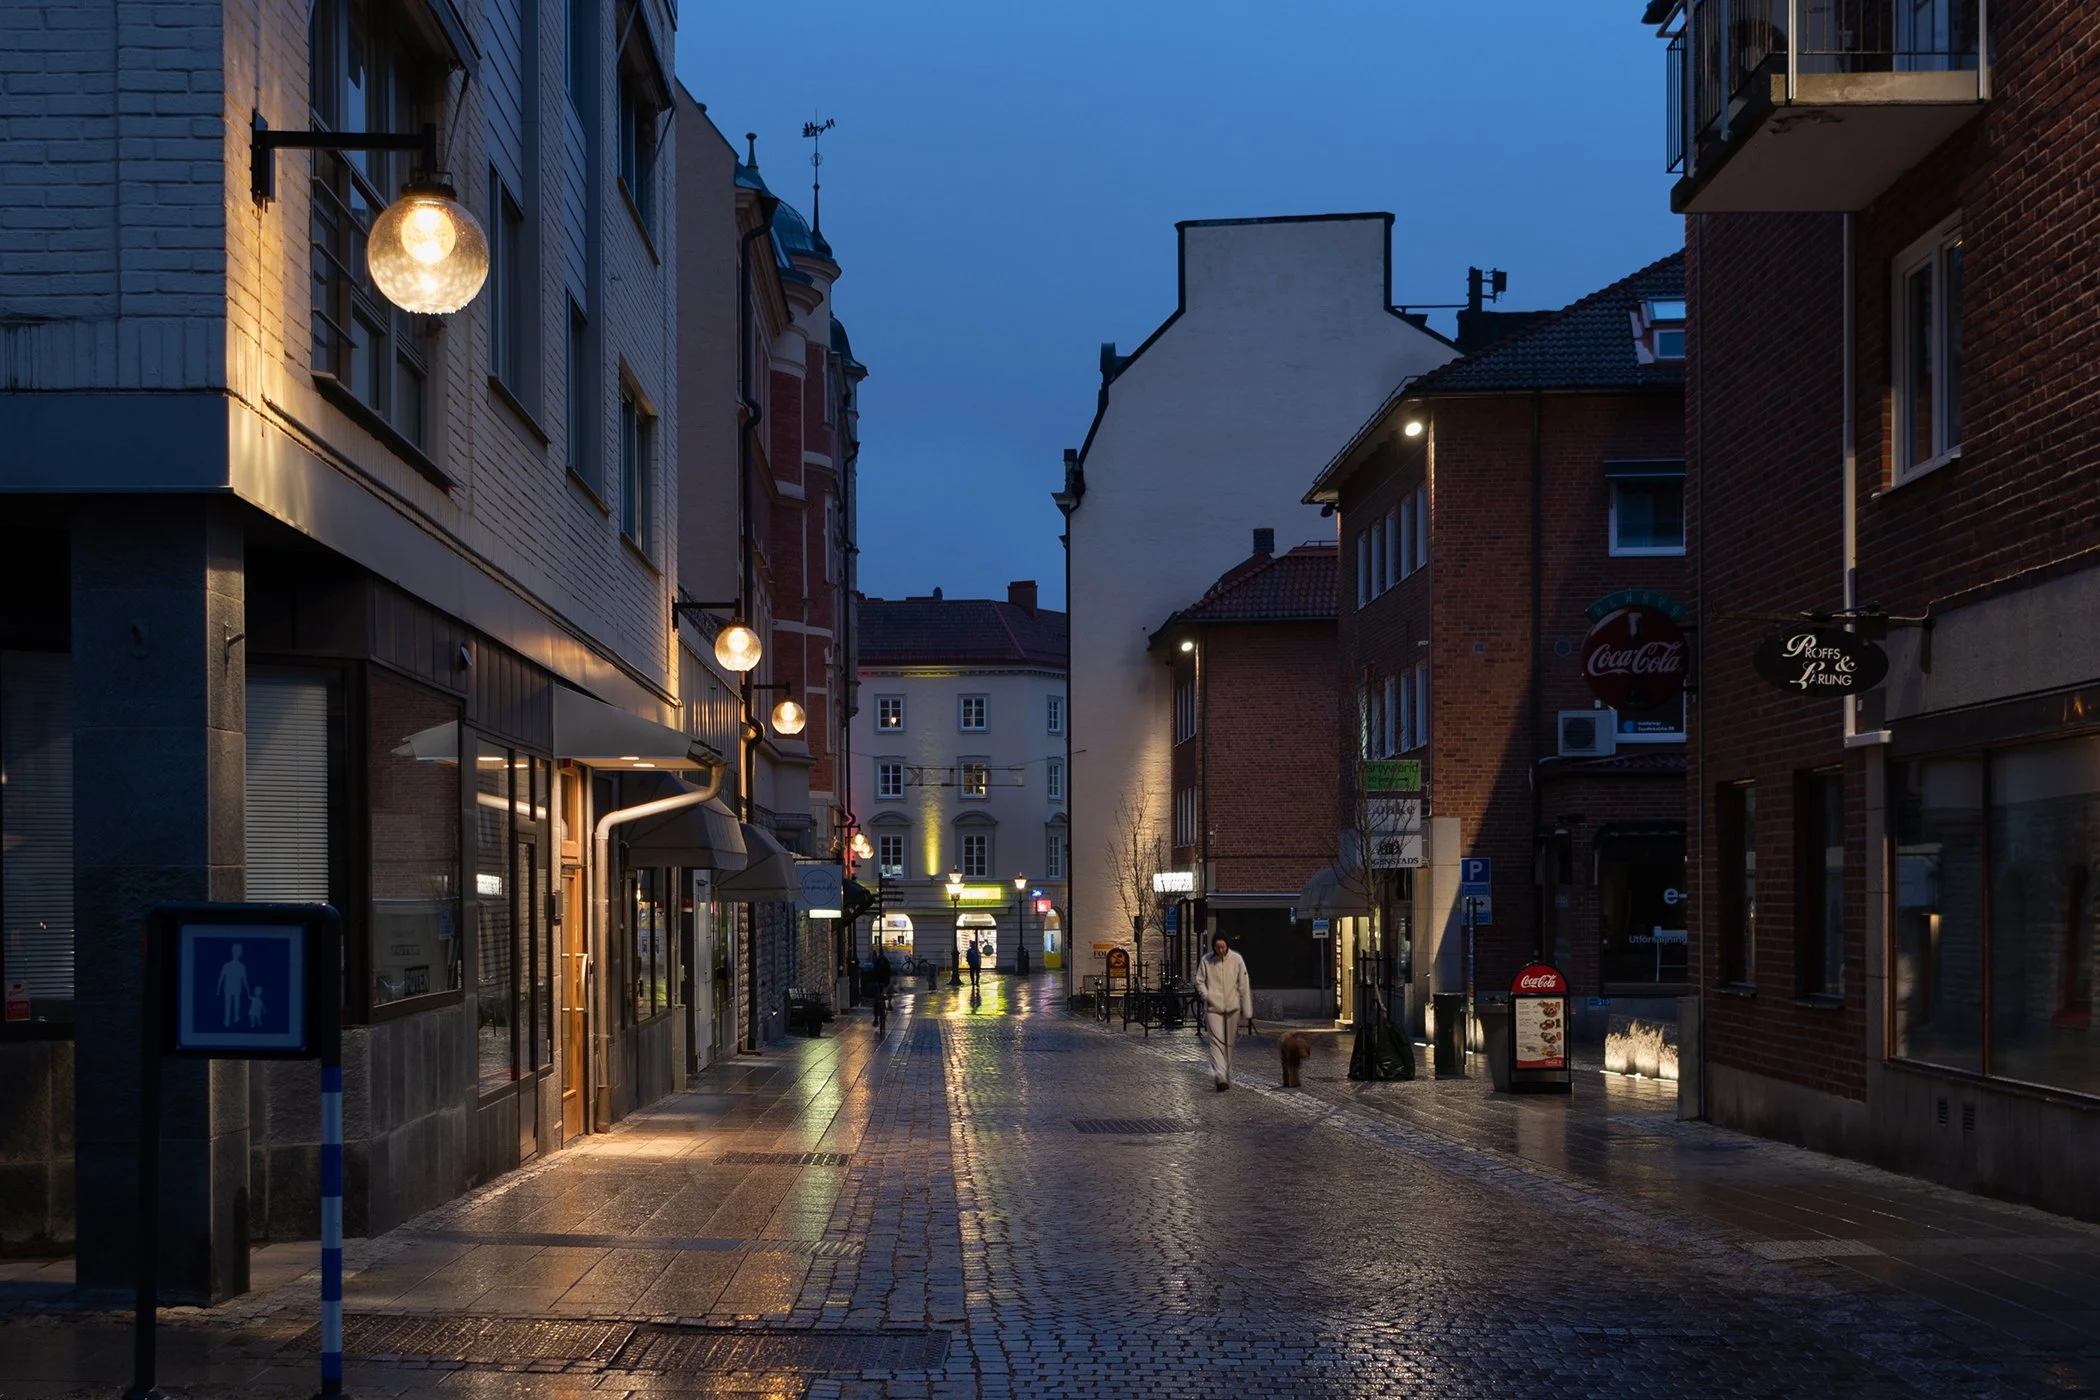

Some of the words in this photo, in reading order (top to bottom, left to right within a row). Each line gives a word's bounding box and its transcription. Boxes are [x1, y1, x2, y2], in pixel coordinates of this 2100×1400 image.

[1782, 633, 1841, 660] PROFFS
[1835, 655, 1858, 673] &
[1469, 861, 1483, 880] P
